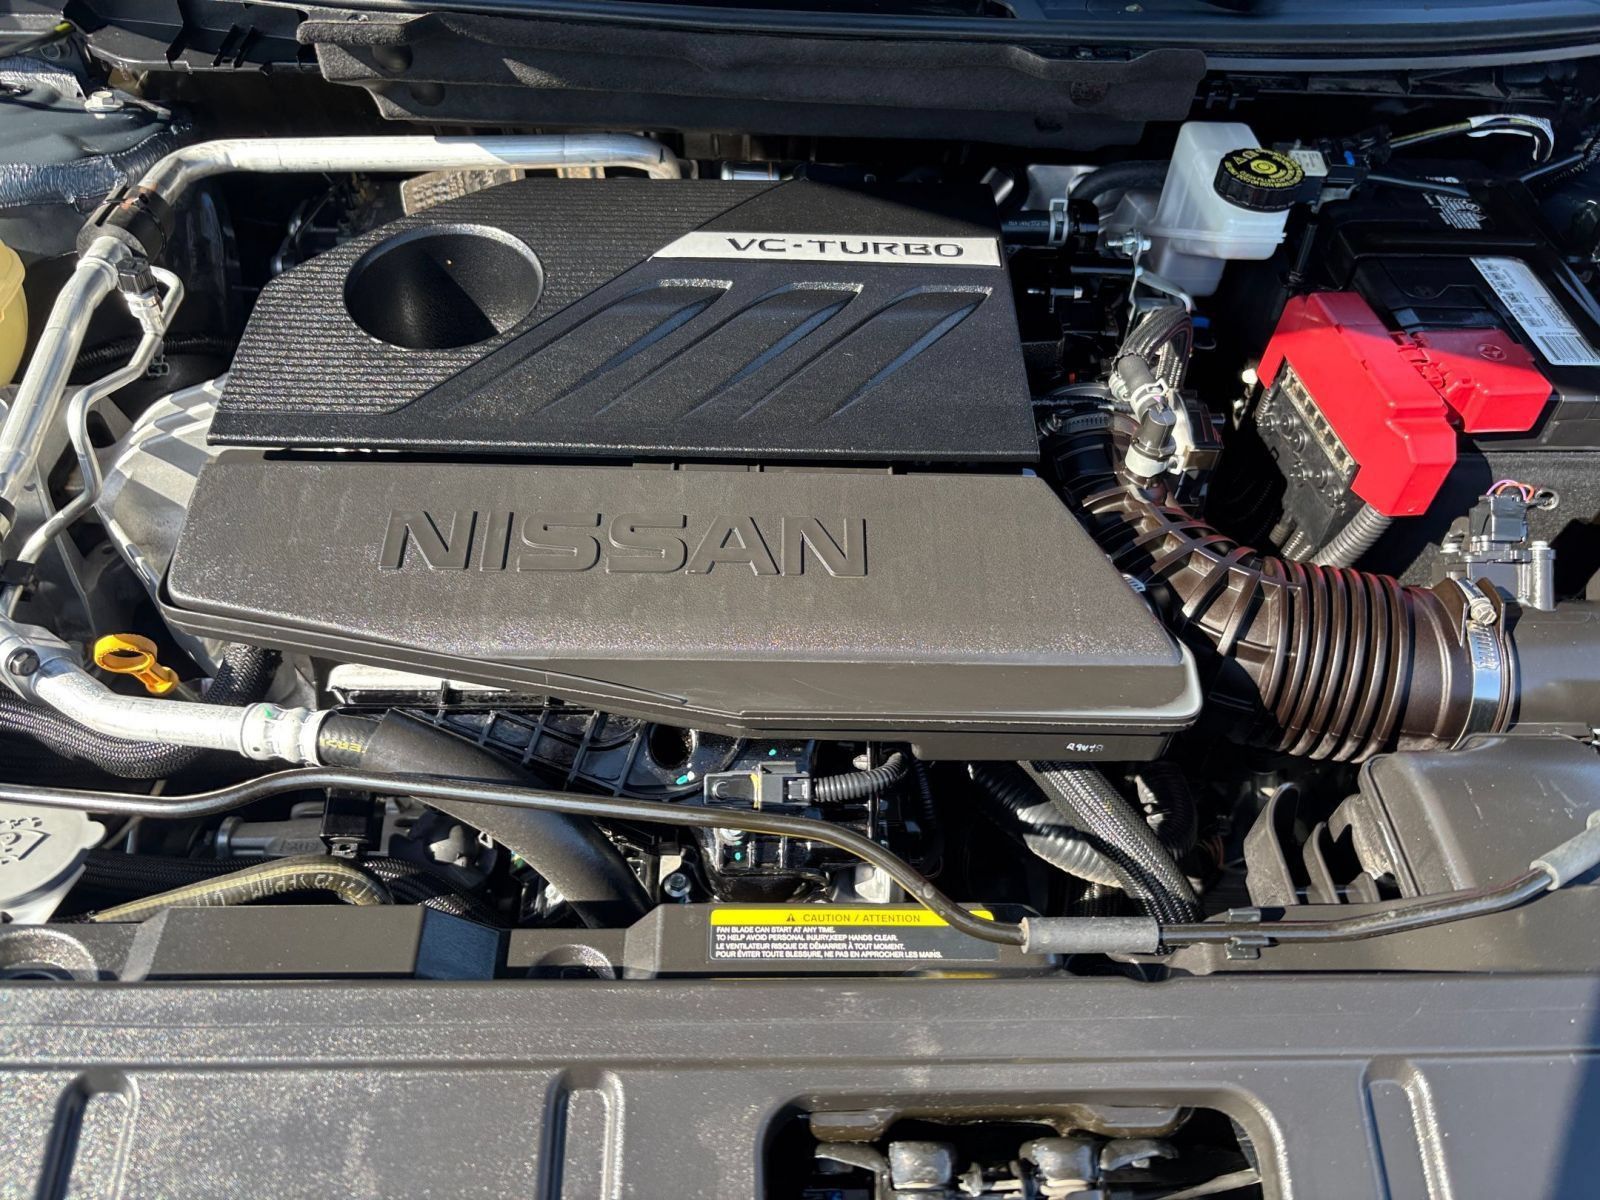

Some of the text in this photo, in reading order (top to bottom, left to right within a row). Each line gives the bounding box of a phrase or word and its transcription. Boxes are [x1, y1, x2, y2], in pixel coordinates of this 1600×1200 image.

[727, 238, 964, 257] VC-TURBO
[379, 510, 868, 578] NISSAN
[803, 914, 920, 923] CAUTION / ATTENTION
[810, 941, 847, 950] DÉMARRER
[848, 942, 854, 950] À
[737, 950, 761, 958] ÉVITER
[785, 951, 823, 959] BLESSURE,
